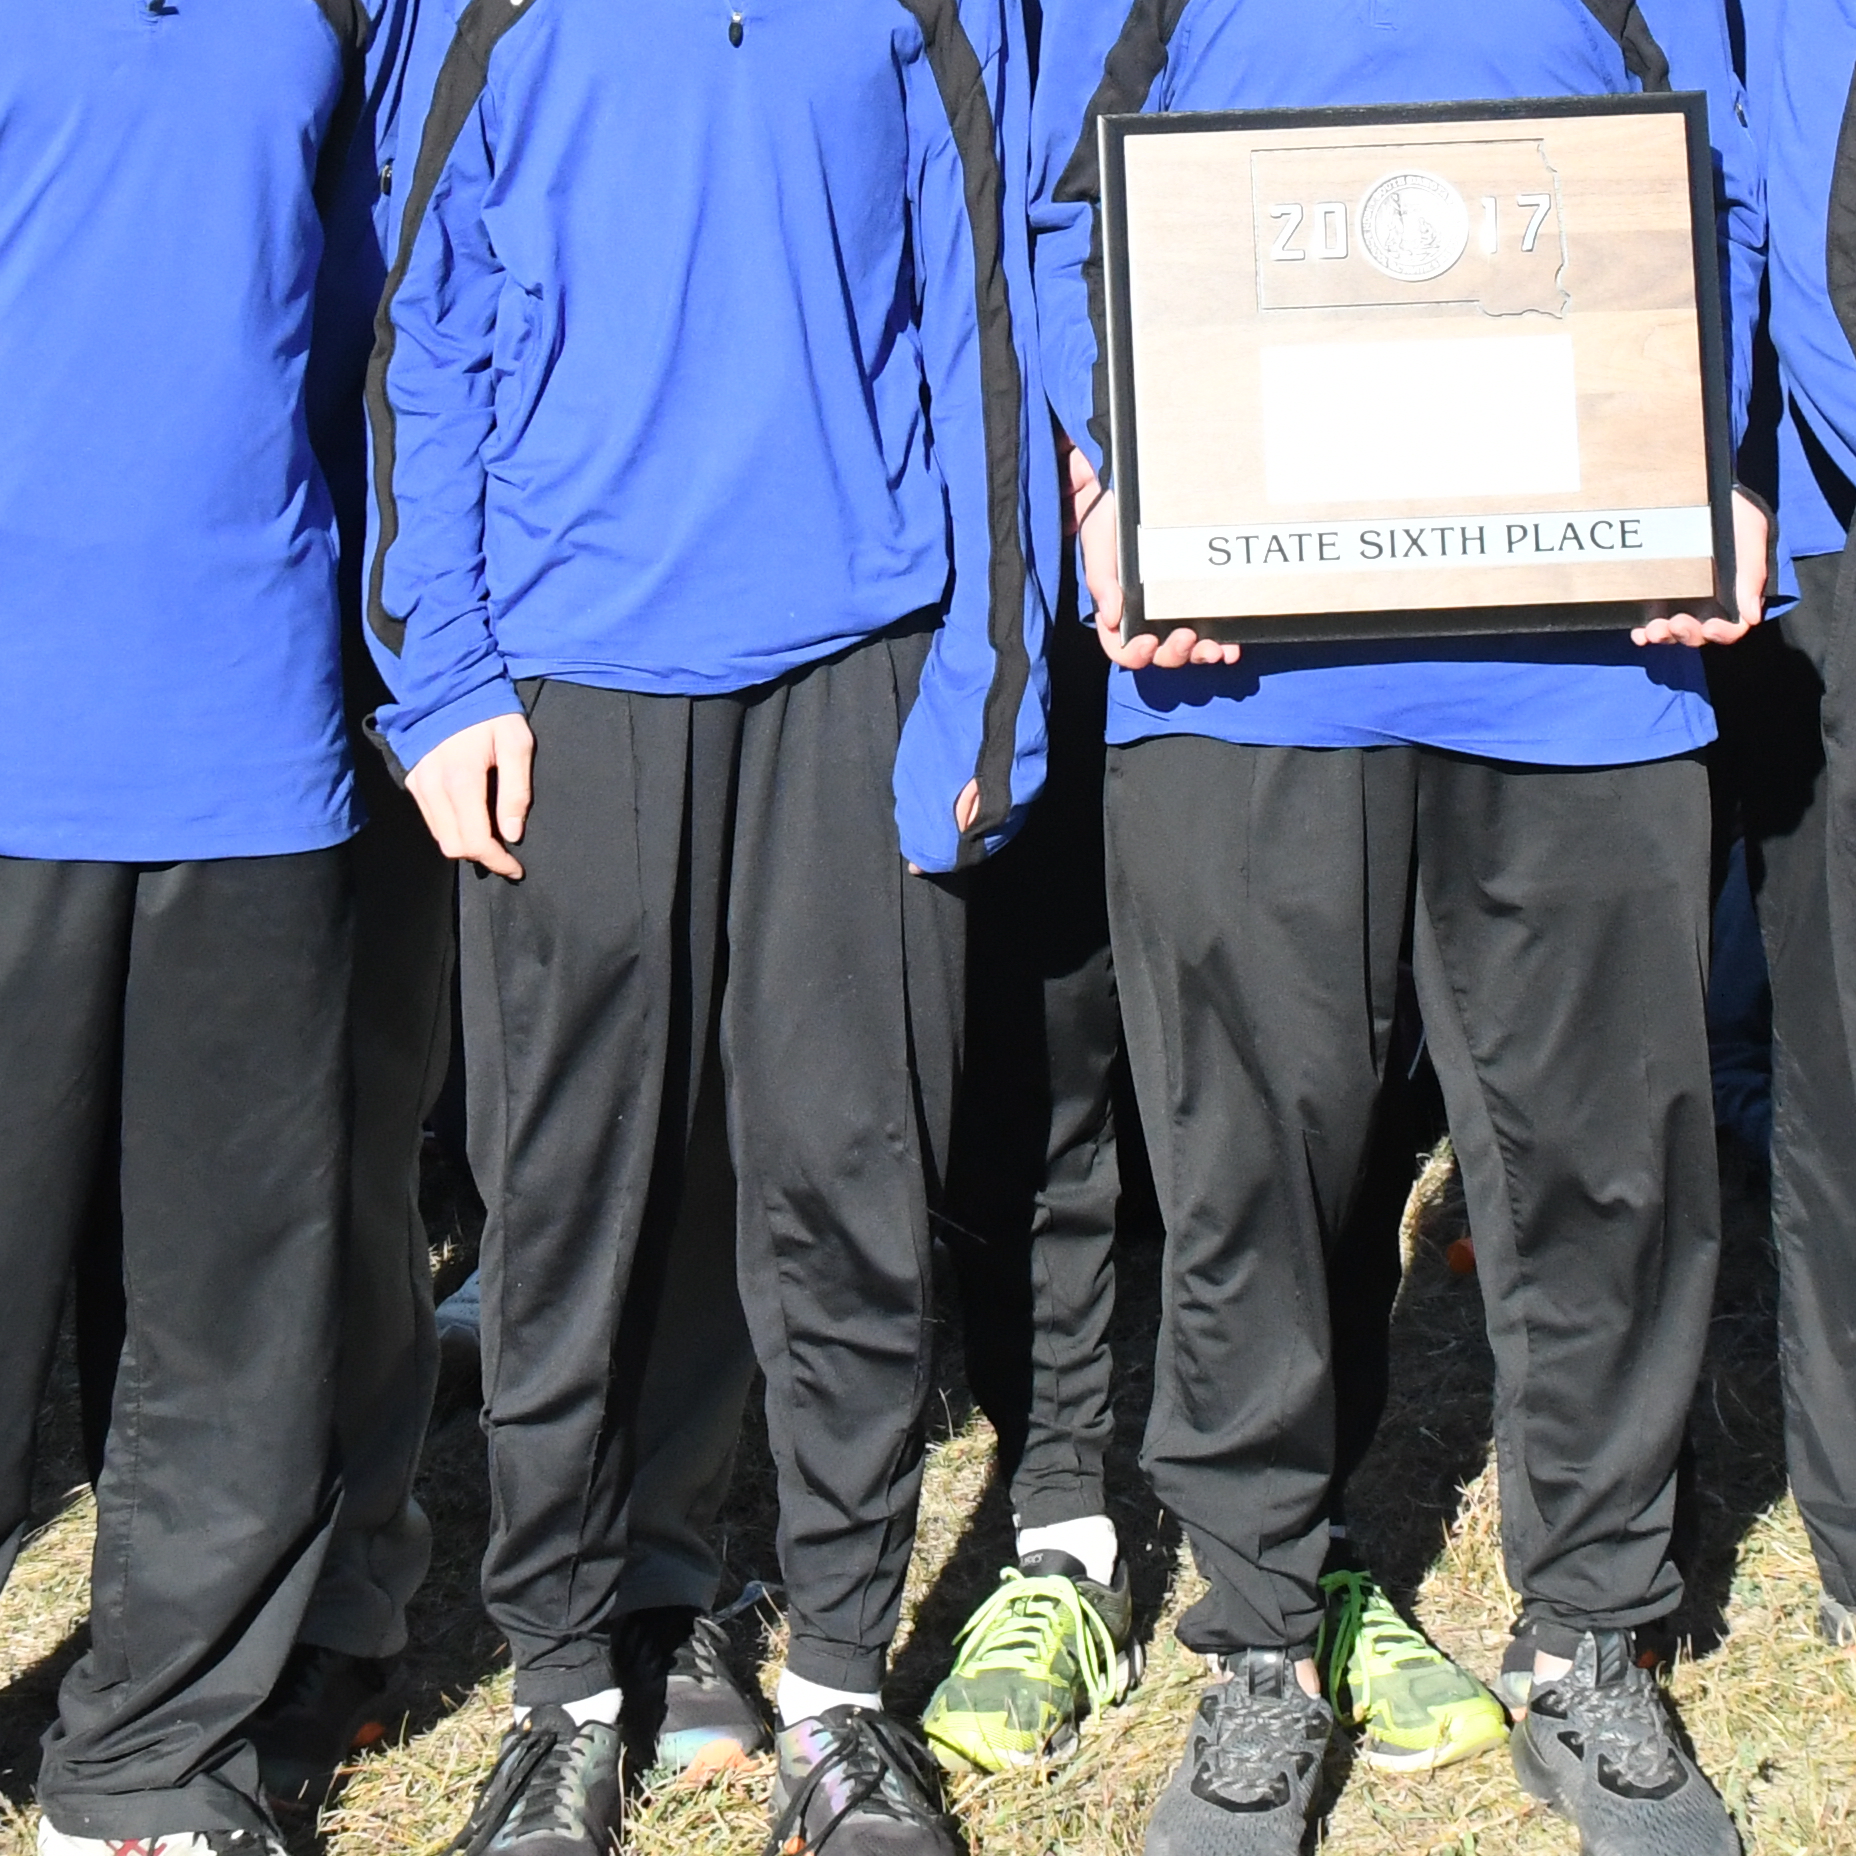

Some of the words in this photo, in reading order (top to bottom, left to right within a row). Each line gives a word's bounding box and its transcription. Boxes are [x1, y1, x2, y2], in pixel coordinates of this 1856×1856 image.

[1207, 531, 1341, 566] STATE
[1359, 525, 1487, 561] SIXTH
[1505, 518, 1644, 554] PLACE
